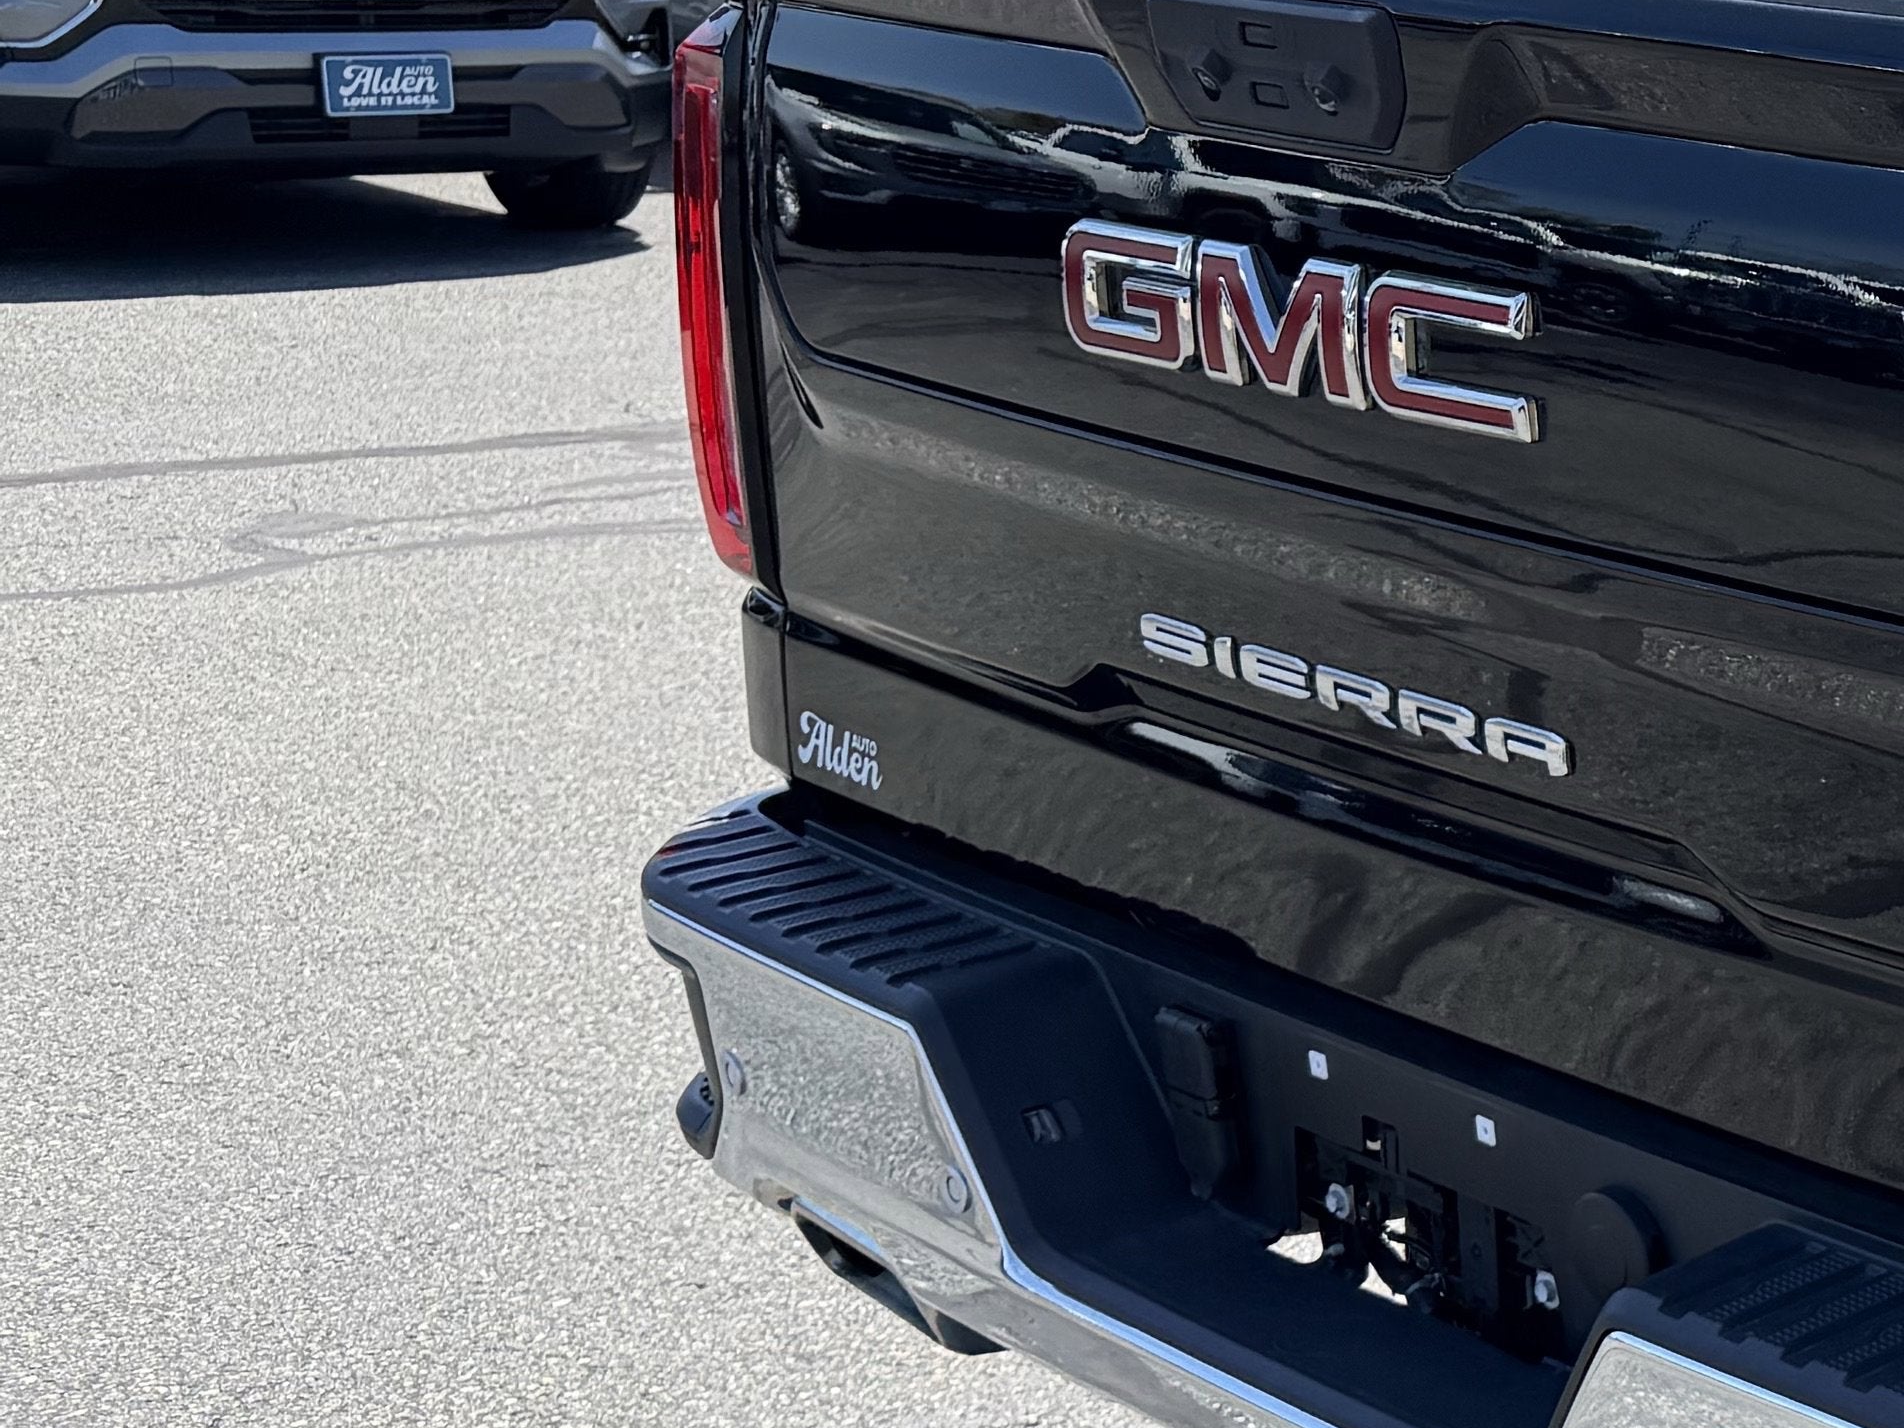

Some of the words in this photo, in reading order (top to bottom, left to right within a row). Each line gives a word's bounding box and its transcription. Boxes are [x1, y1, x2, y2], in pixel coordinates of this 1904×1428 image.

[339, 65, 439, 96] Alden
[403, 66, 434, 76] AUTO
[343, 95, 377, 107] LOVE
[381, 95, 393, 106] IT
[396, 94, 439, 106] LOCAL
[1062, 218, 1541, 444] GMC
[1140, 613, 1570, 778] SIERRA
[798, 710, 883, 791] Alden
[851, 733, 878, 757] AUTO
